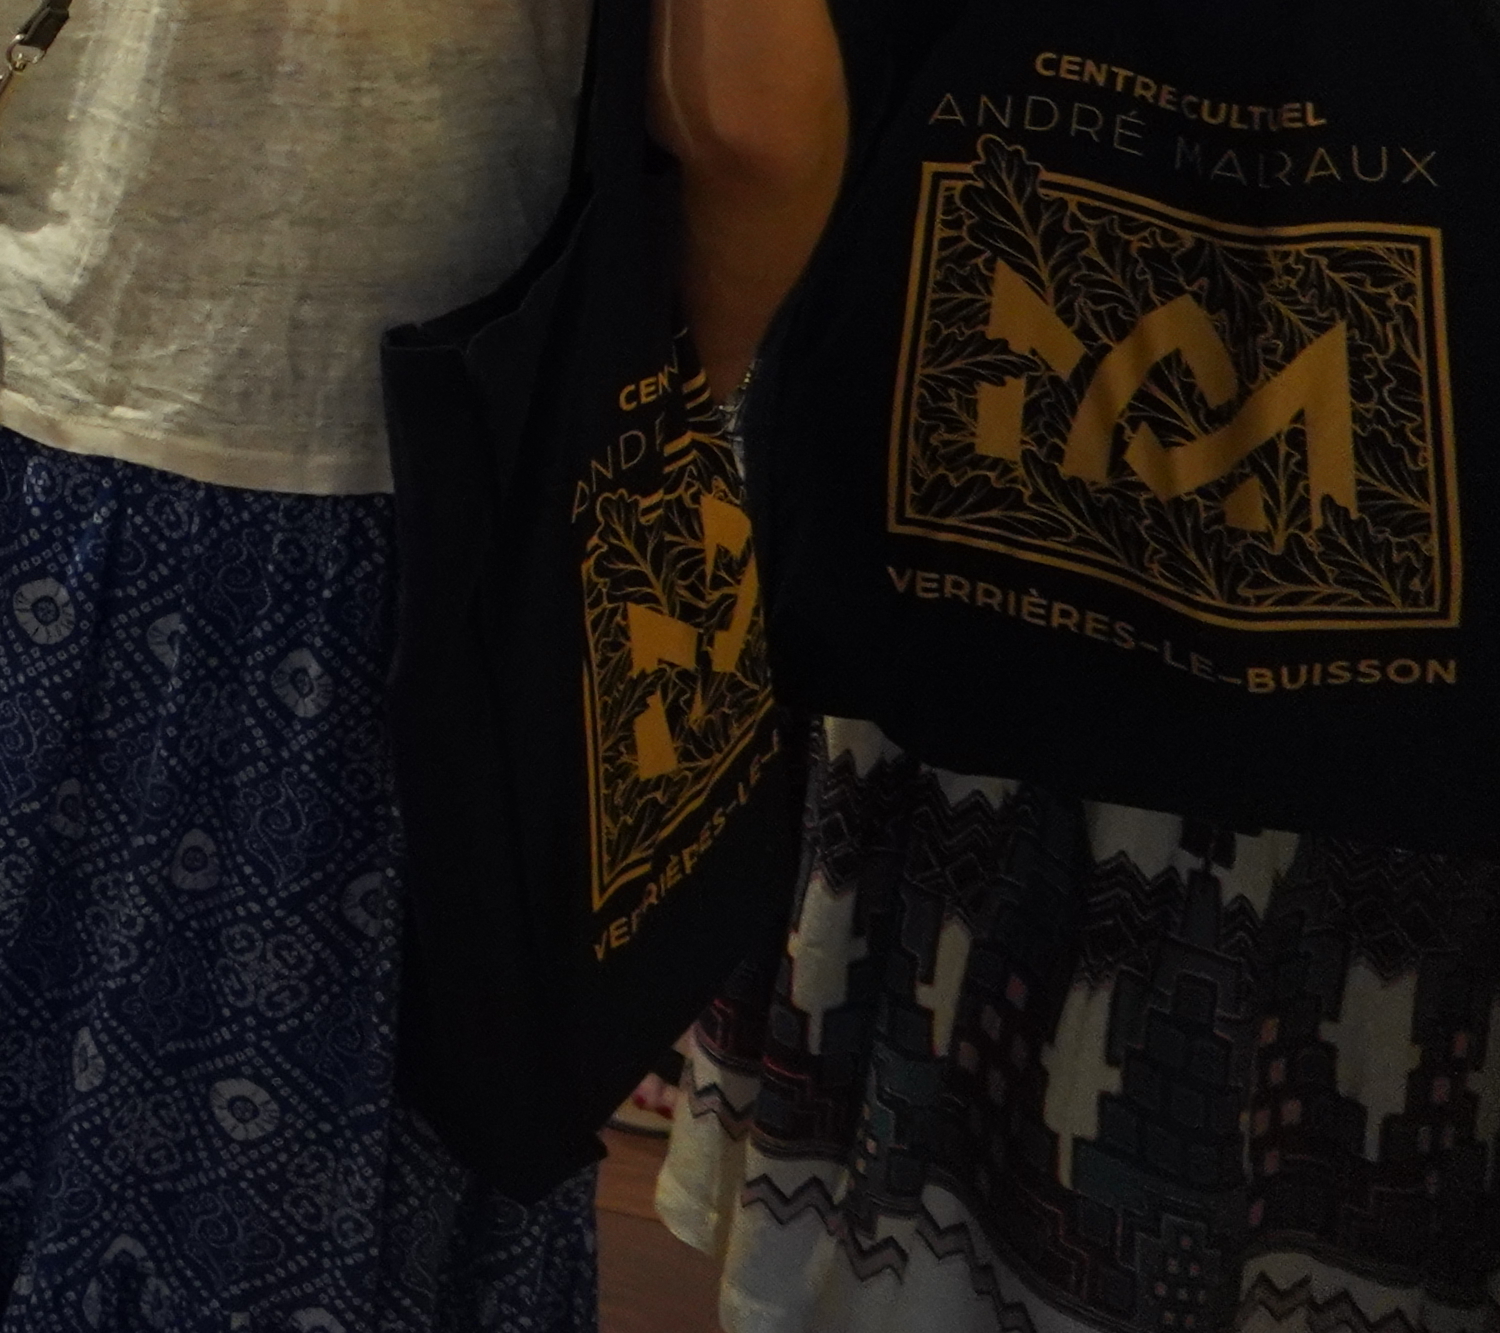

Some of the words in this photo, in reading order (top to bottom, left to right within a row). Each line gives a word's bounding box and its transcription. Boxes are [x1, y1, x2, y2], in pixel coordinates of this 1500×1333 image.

[1033, 50, 1179, 111] CENTRE
[927, 92, 1146, 156] ANDRÉ
[886, 564, 1458, 695] VERRIÈRES-LE-BUISSON
